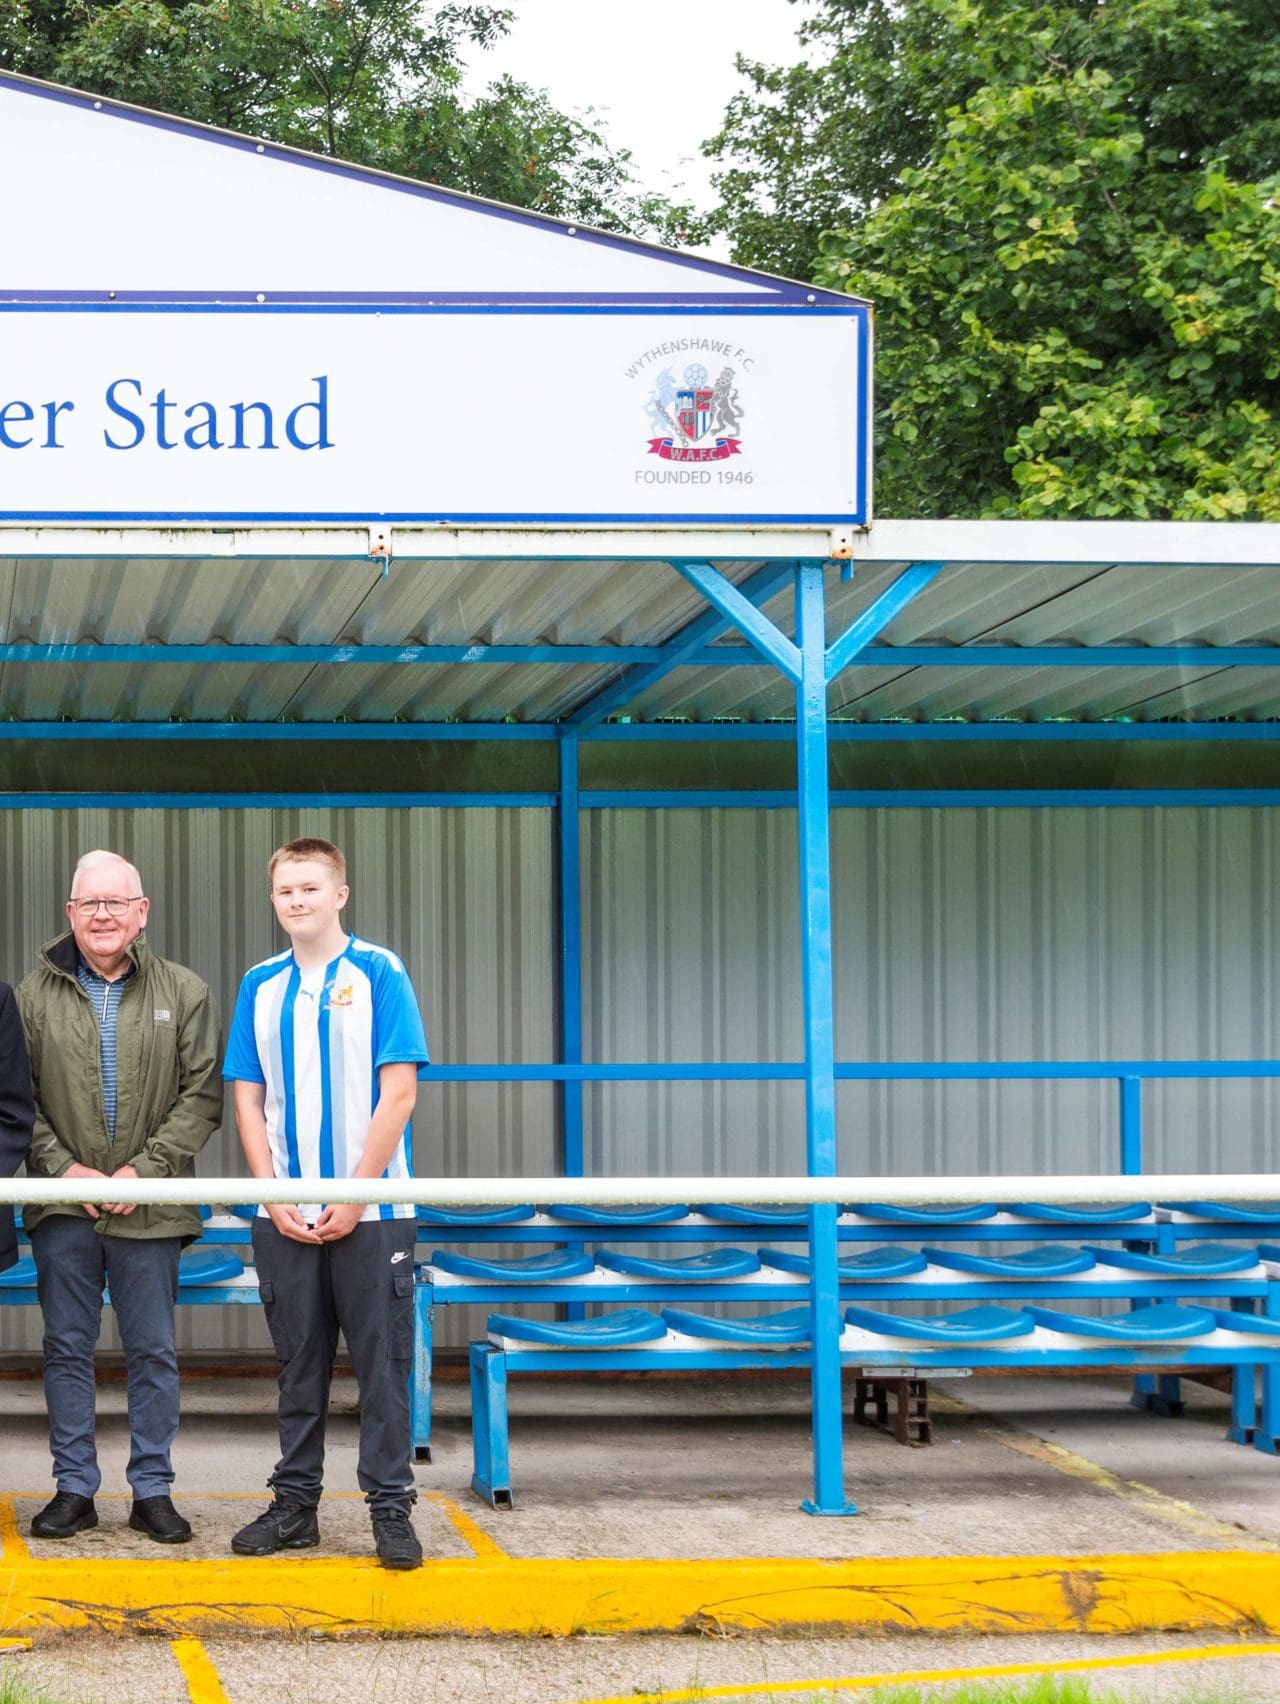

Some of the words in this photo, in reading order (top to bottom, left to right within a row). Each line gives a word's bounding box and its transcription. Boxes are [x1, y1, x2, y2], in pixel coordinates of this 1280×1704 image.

[624, 338, 733, 380] WYTHENSHAWE
[734, 348, 755, 372] F.C.
[103, 375, 336, 450] Stand
[635, 470, 712, 485] FOUNDED
[717, 471, 754, 485] 1946
